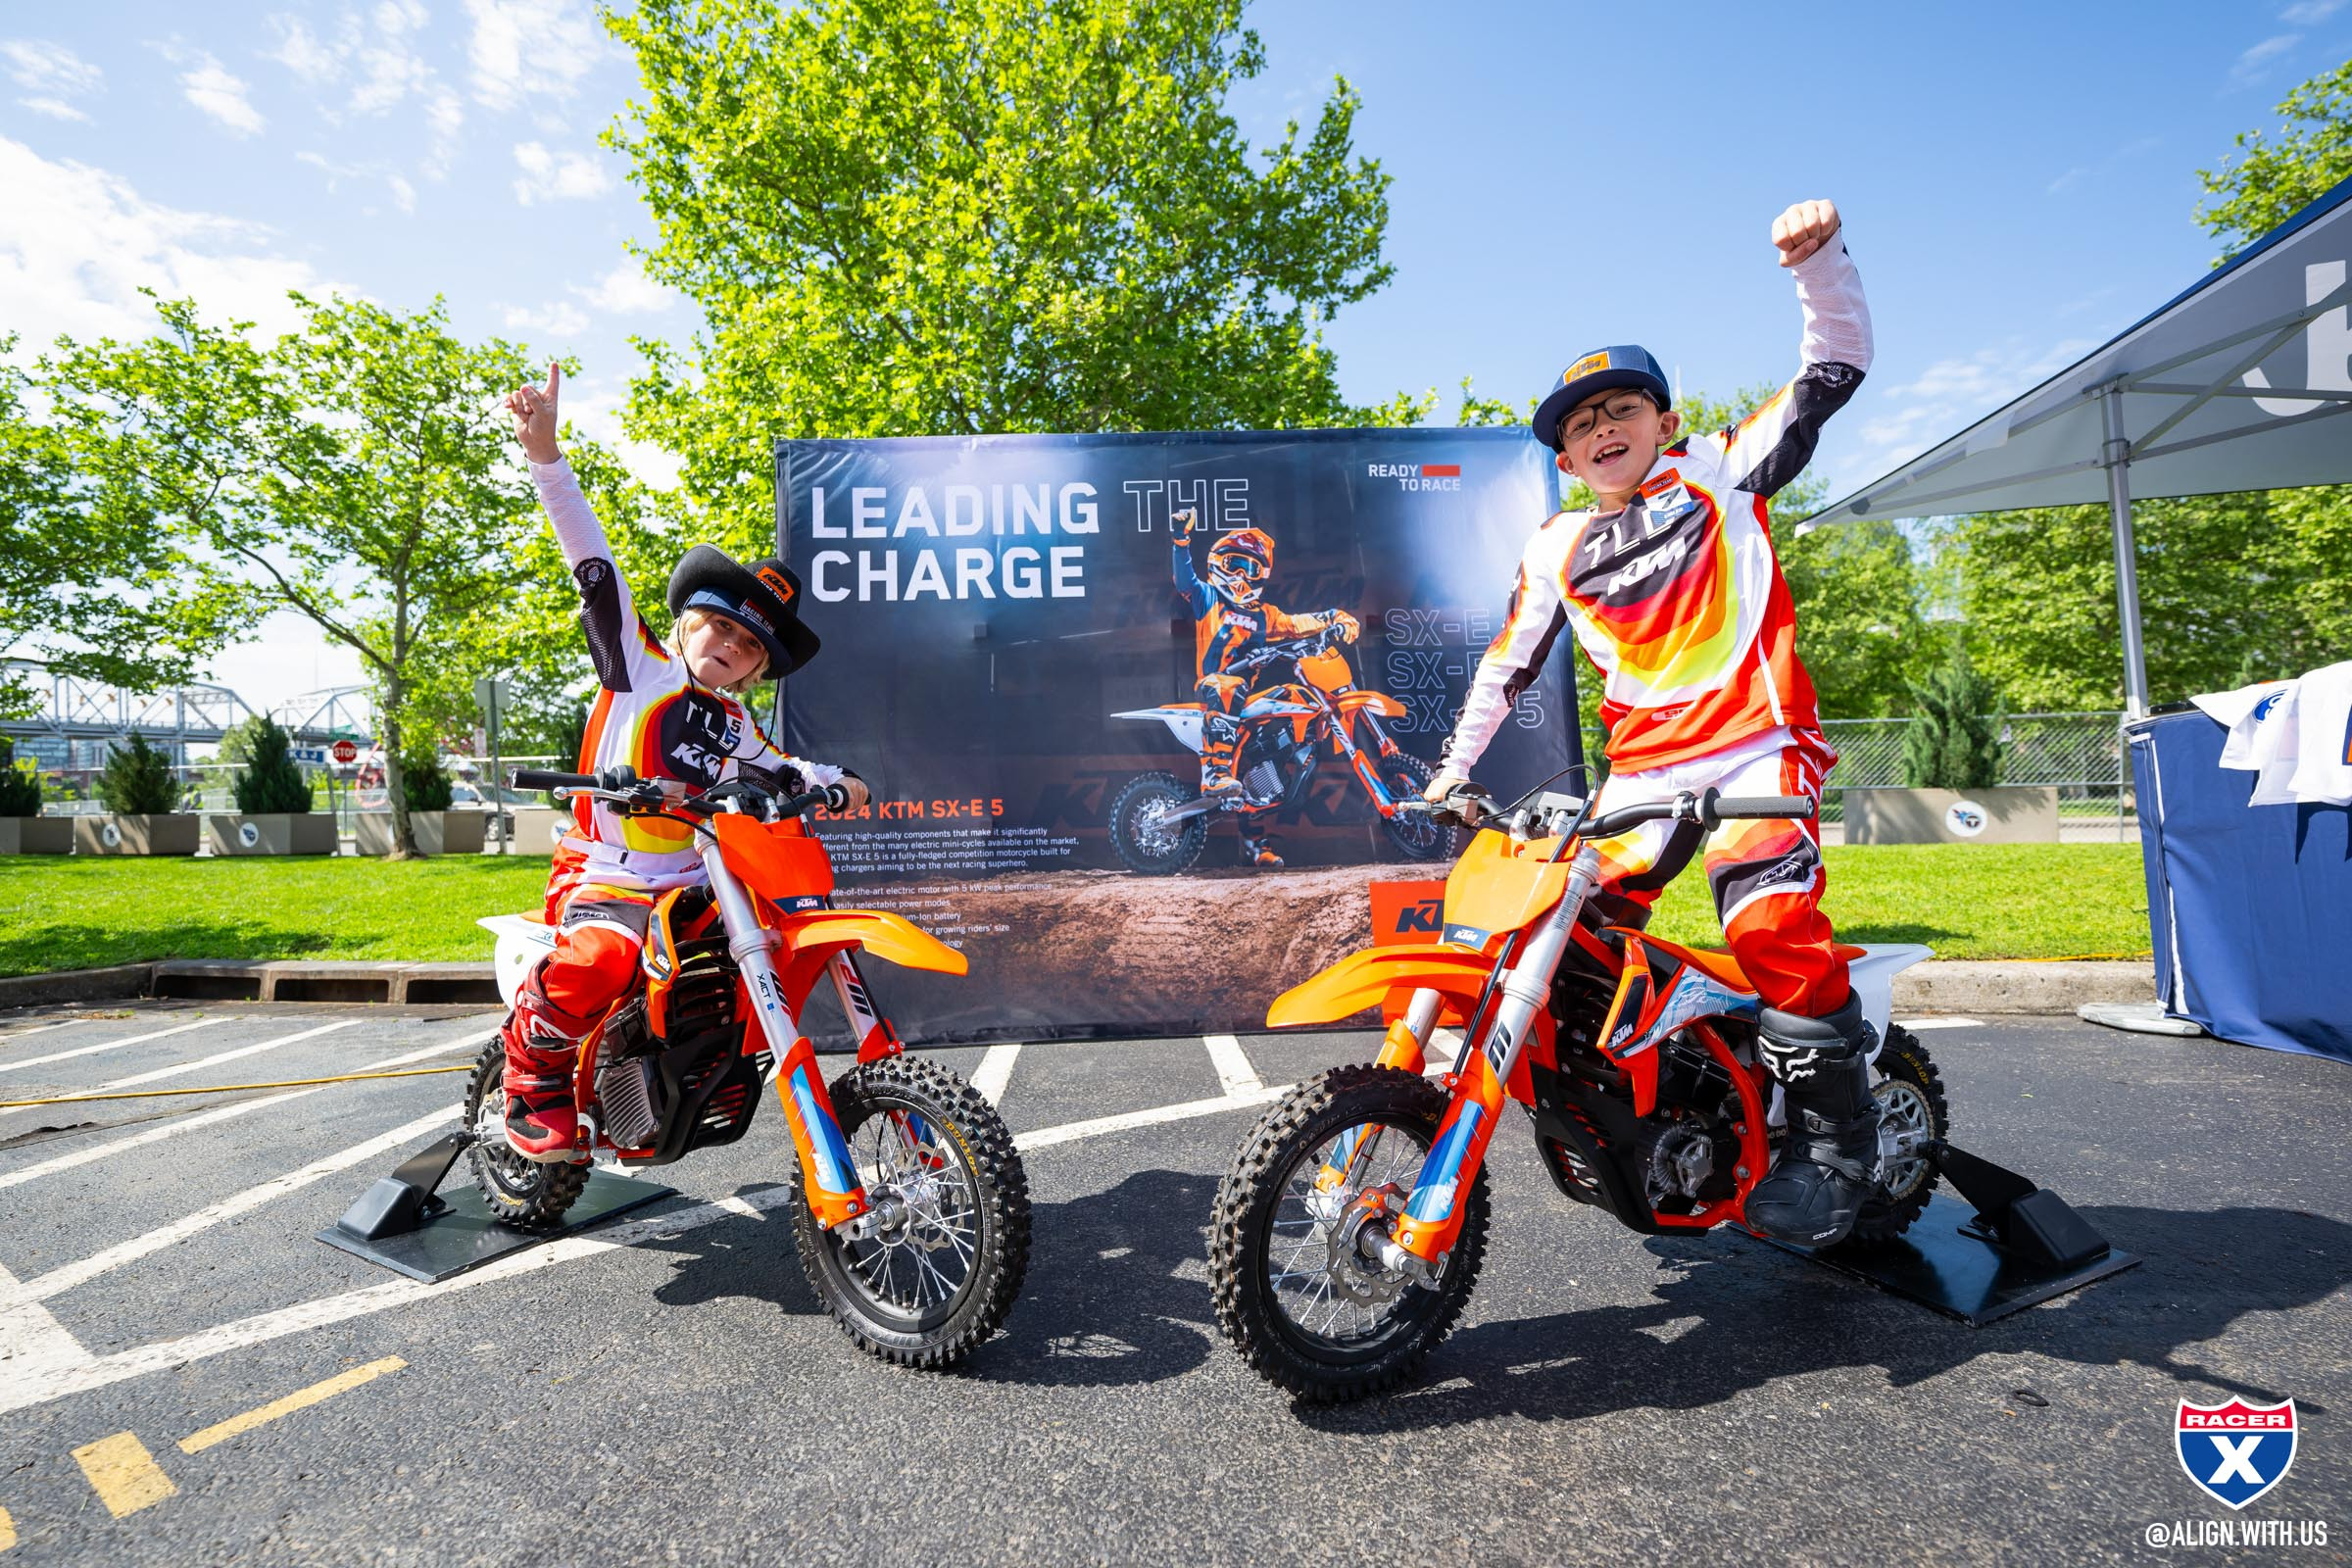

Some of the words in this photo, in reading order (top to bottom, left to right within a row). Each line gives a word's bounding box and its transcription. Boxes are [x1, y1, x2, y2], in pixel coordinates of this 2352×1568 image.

[1368, 464, 1419, 478] READY
[1398, 478, 1419, 491] TO
[1421, 478, 1461, 491] RACE
[1658, 487, 1682, 509] 7
[811, 481, 1100, 539] LEADING
[1123, 478, 1251, 533] THE
[811, 545, 1086, 603] CHARGE
[1607, 536, 1686, 597] KTM
[1223, 612, 1257, 632] KTM
[1385, 608, 1492, 646] SX-E
[1516, 690, 1544, 729] 5
[730, 718, 742, 734] 5
[334, 747, 357, 758] STOP
[879, 801, 924, 819] KTM
[931, 799, 983, 819] SX-E
[991, 799, 1004, 816] 5
[815, 832, 853, 842] Featuring
[855, 831, 902, 842] high-quality
[904, 830, 951, 841] components
[970, 828, 992, 837] make
[994, 827, 999, 836] it
[1002, 827, 1049, 837] significantly
[872, 842, 886, 851] the
[888, 842, 908, 853] many
[943, 839, 986, 849] mini-cycles
[988, 838, 1021, 847] available
[831, 853, 849, 861] KTM
[853, 853, 870, 861] SX-E
[899, 851, 947, 861] fully-fledged
[949, 849, 994, 858] competition
[996, 849, 1039, 858] motorcycle
[1041, 847, 1058, 856] built
[841, 863, 874, 873] chargers
[877, 863, 905, 872] aiming
[962, 860, 986, 869] racing
[988, 858, 1029, 868] superhero.
[831, 887, 884, 896] ate-of-the-art
[886, 886, 915, 895] electric
[984, 884, 1002, 893] peak
[1004, 883, 1053, 893] performance
[796, 898, 818, 908] KTM
[857, 900, 896, 909] selectable
[934, 911, 960, 921] battery
[1396, 899, 1445, 933] KT
[935, 925, 965, 936] growing
[1453, 929, 1479, 942] KTM
[757, 973, 770, 998] XACT
[1611, 1023, 1634, 1048] KTM
[946, 1121, 980, 1176] DUNLOP
[1813, 1227, 1838, 1241] COMP
